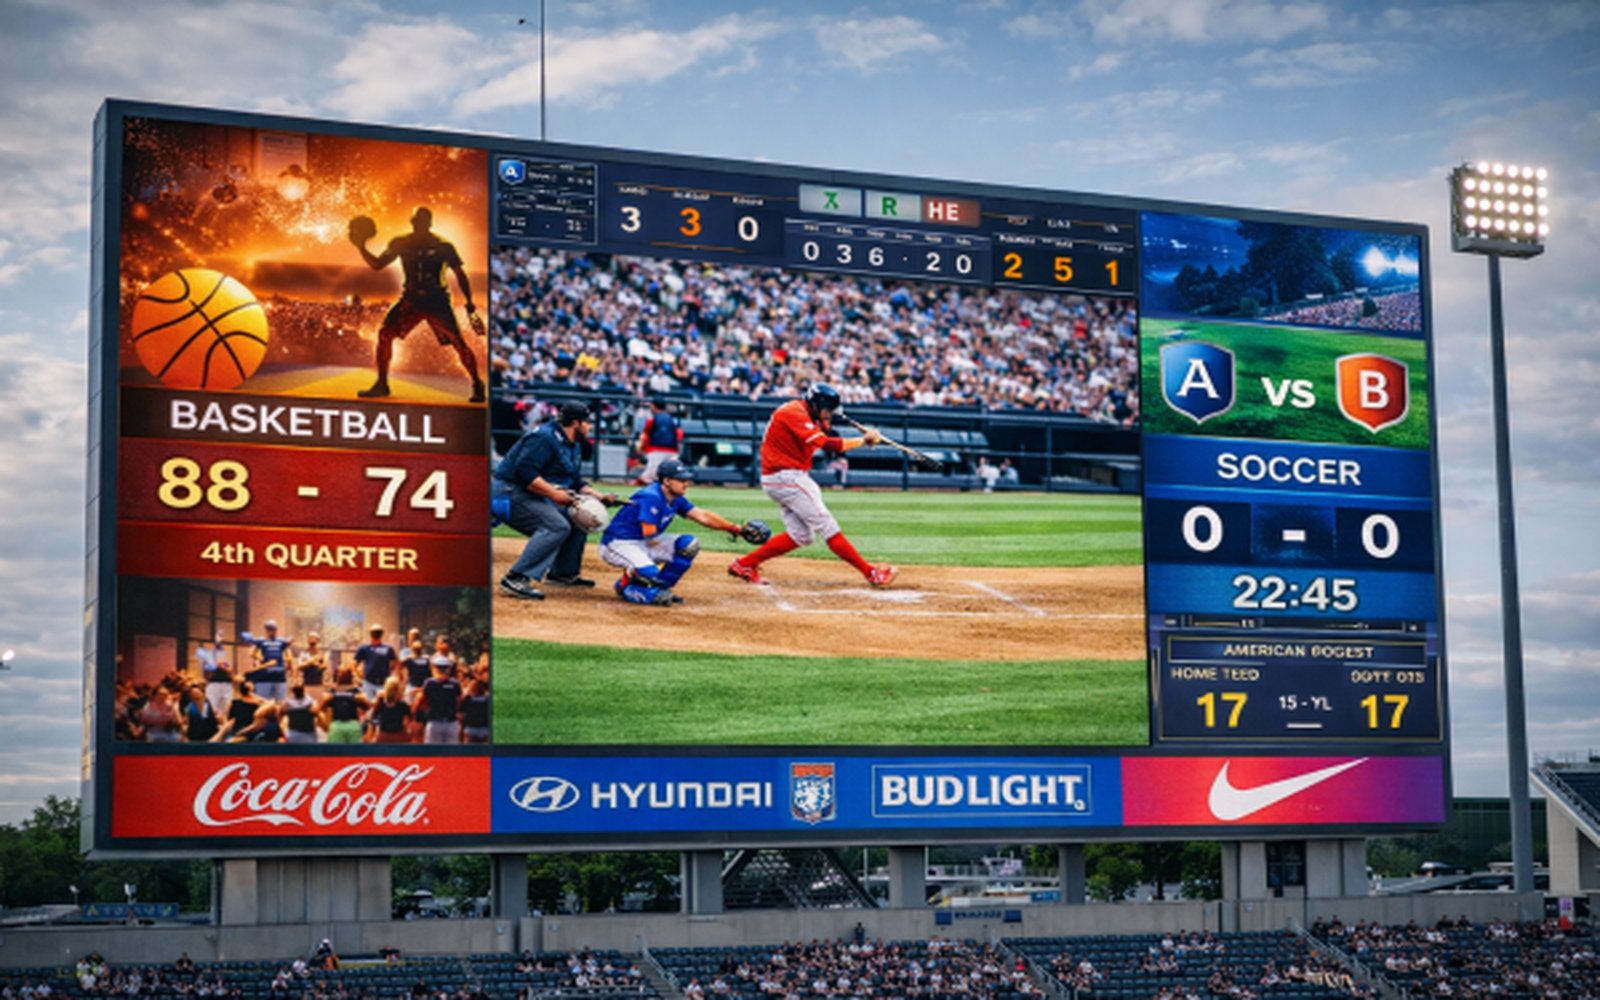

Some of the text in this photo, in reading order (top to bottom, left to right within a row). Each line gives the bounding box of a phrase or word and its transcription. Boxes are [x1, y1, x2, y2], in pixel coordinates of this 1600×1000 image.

[823, 191, 840, 210] X
[881, 196, 898, 216] R
[927, 201, 960, 222] HE
[620, 206, 642, 233] 3
[679, 207, 703, 237] 3
[737, 215, 760, 242] 0
[803, 241, 820, 262] 0
[836, 244, 853, 265] 3
[868, 246, 885, 267] 6
[926, 251, 942, 272] 2
[955, 254, 972, 274] 0
[1003, 252, 1119, 286] 2 5 1
[1176, 358, 1222, 400] A
[1358, 369, 1391, 410] B
[170, 399, 446, 445] BASKETBALL
[1216, 453, 1362, 486] SOCCER
[157, 456, 251, 511] 88
[364, 466, 455, 520] 74
[1181, 505, 1224, 553] 0
[1360, 513, 1400, 559] 0
[200, 540, 419, 571] 4th QUARTER
[1231, 575, 1358, 612] 22:45
[1223, 644, 1306, 658] AMERICAN
[1170, 667, 1217, 681] HOME
[1196, 692, 1249, 729] 17
[1278, 695, 1298, 709] 15
[1359, 693, 1410, 729] 17
[591, 782, 773, 808] HYUNDAI
